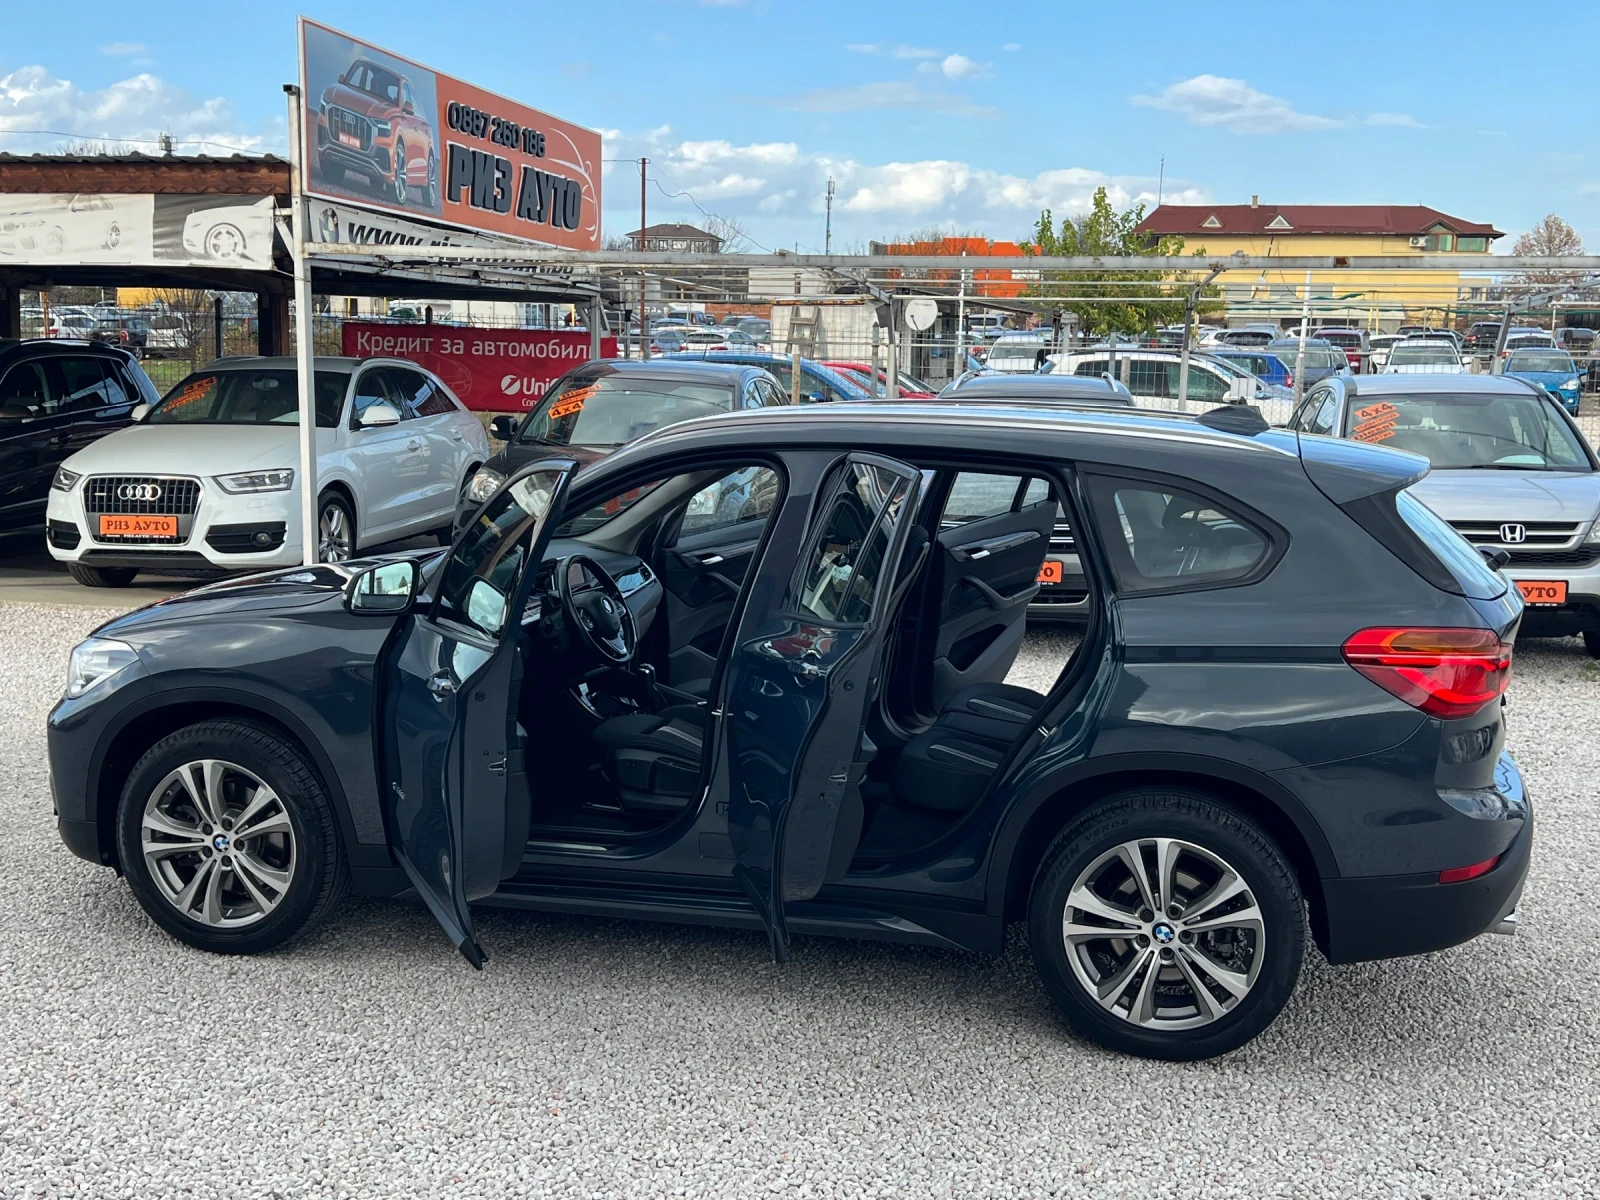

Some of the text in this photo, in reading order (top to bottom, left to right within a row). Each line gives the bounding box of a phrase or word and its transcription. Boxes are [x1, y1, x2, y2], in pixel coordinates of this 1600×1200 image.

[447, 101, 546, 158] 0887 260 186
[447, 140, 582, 232] РИЗ АУТО
[357, 331, 591, 359] Кредит за автомобил
[185, 378, 214, 391] 4x4
[552, 403, 582, 416] 4x4
[1361, 403, 1392, 417] 4x4
[106, 520, 170, 531] РИЗ АУТО
[1522, 586, 1557, 598] УТО
